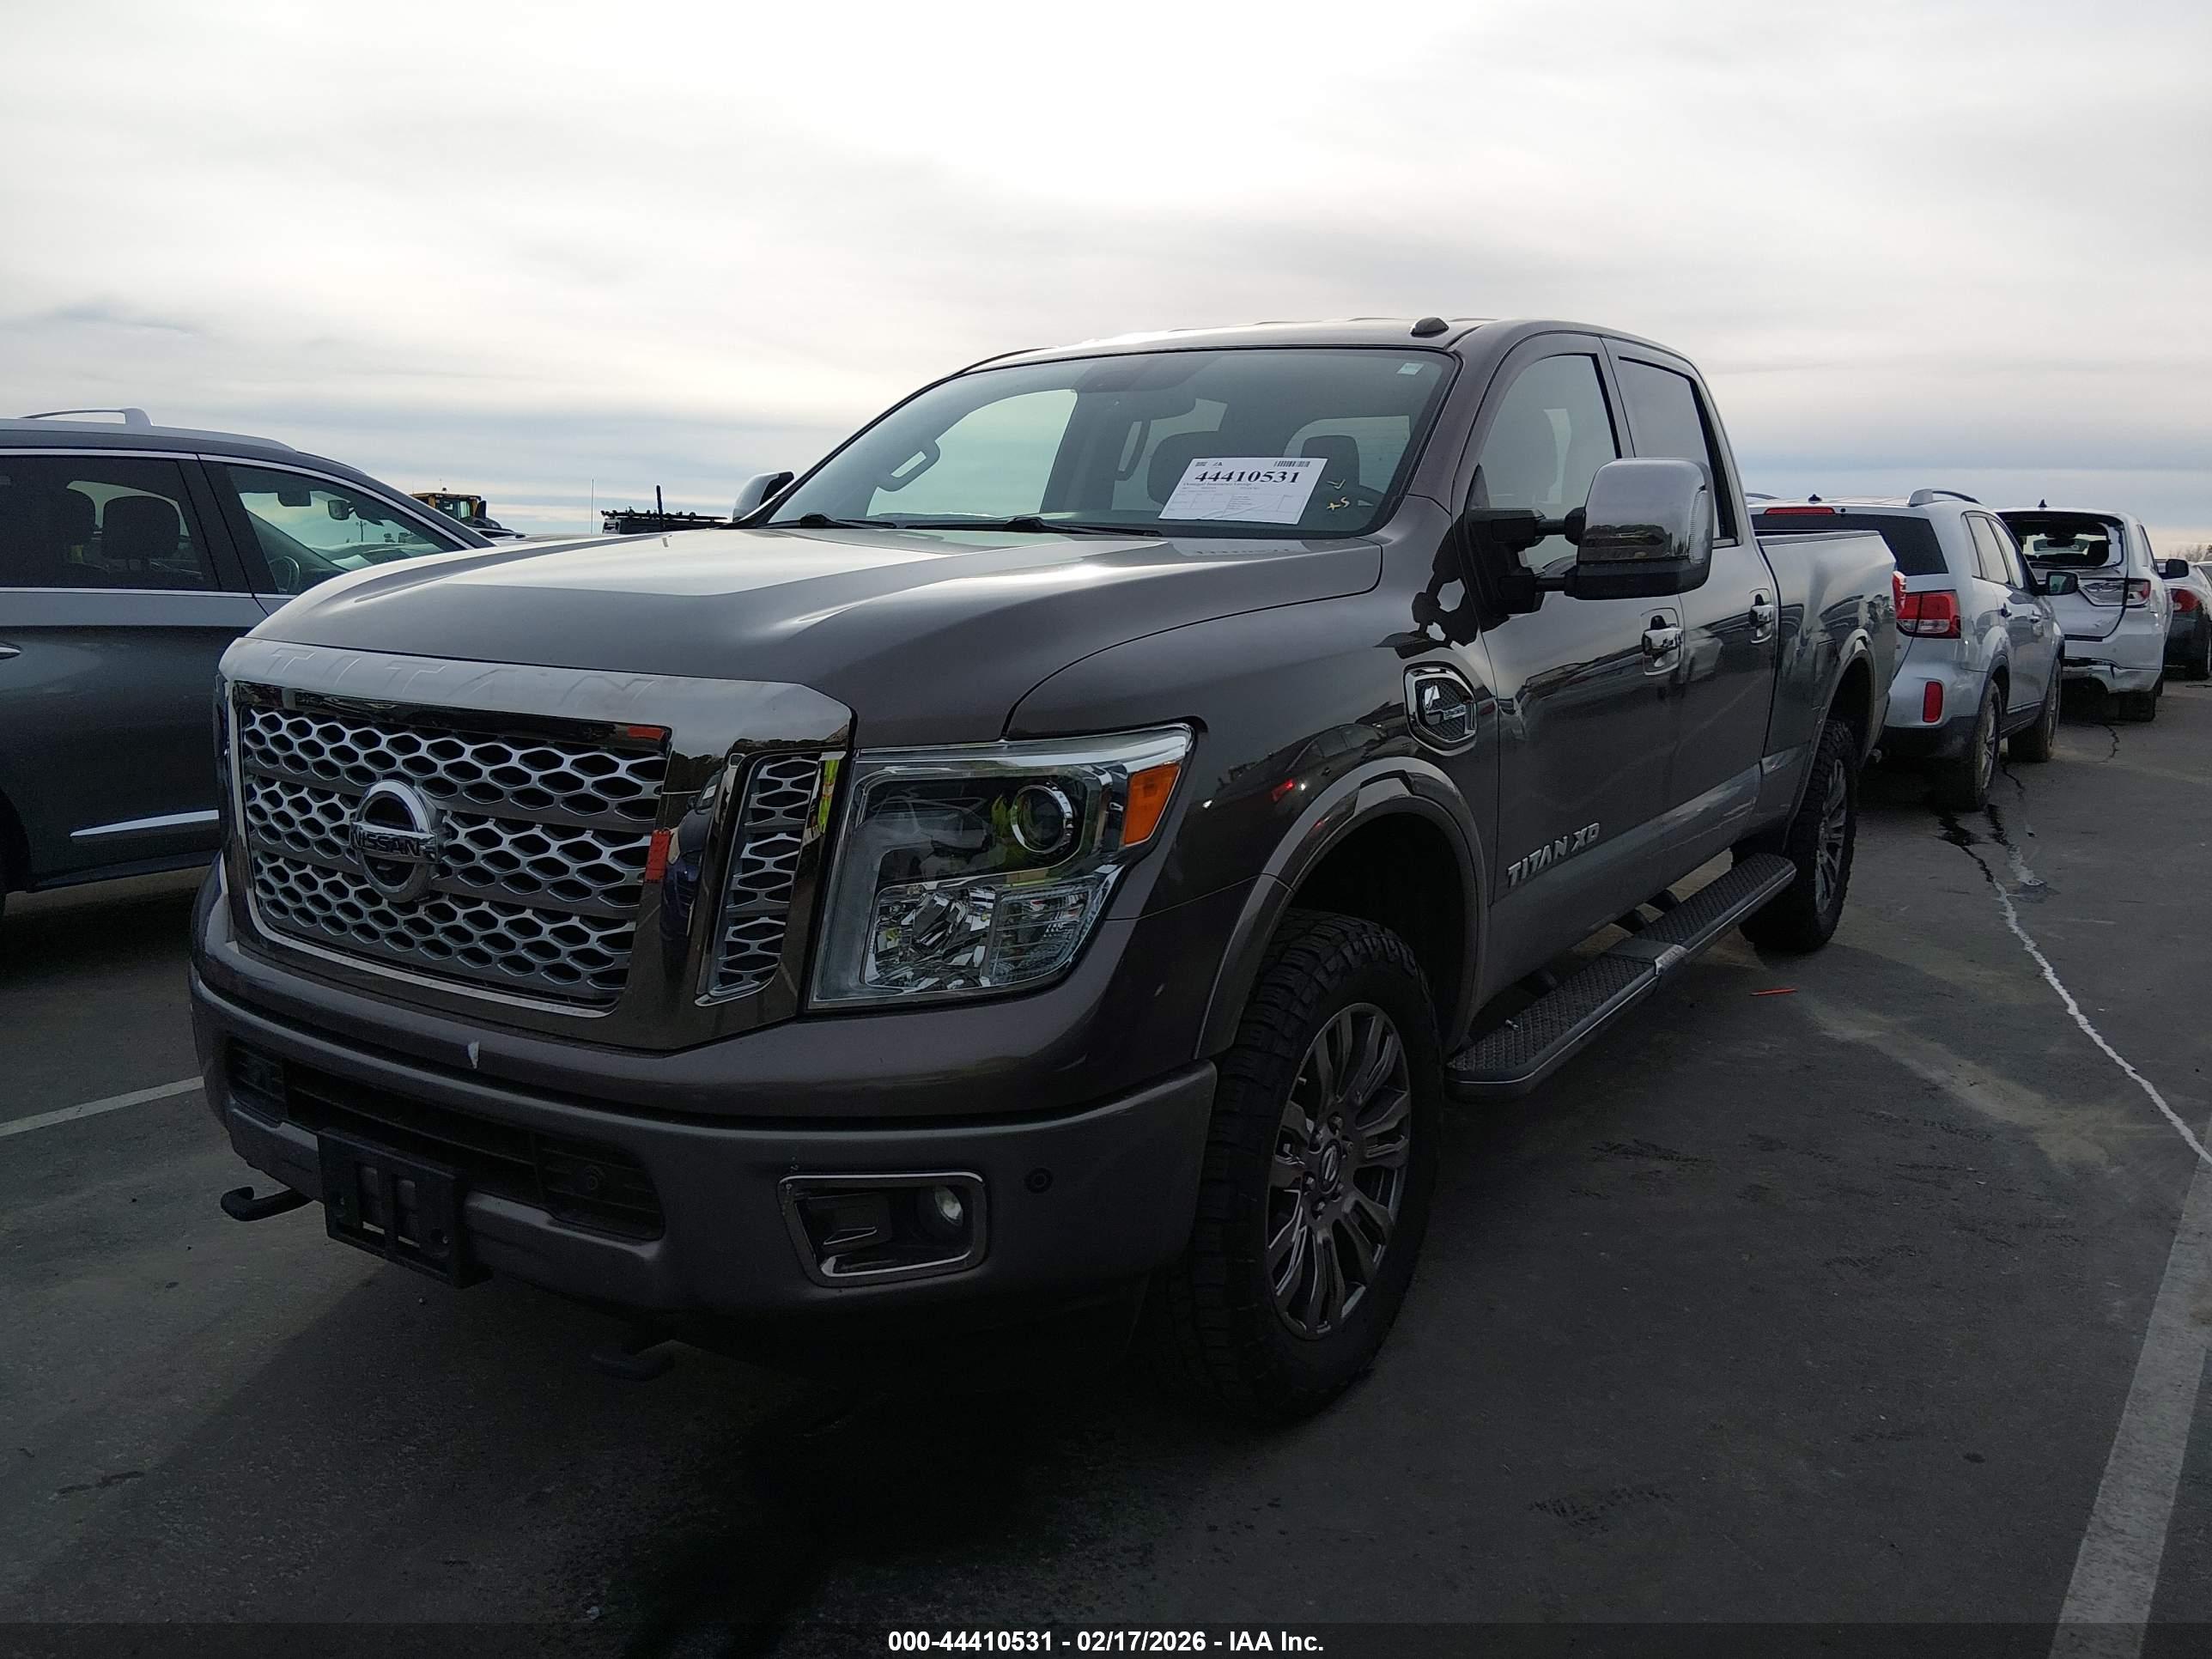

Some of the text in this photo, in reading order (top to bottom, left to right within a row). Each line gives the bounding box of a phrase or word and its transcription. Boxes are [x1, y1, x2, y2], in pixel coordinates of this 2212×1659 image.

[1194, 471, 1302, 483] 44410531
[264, 647, 658, 709] TITAN
[350, 829, 422, 858] NISSAN
[1508, 822, 1601, 887] TITAN XD
